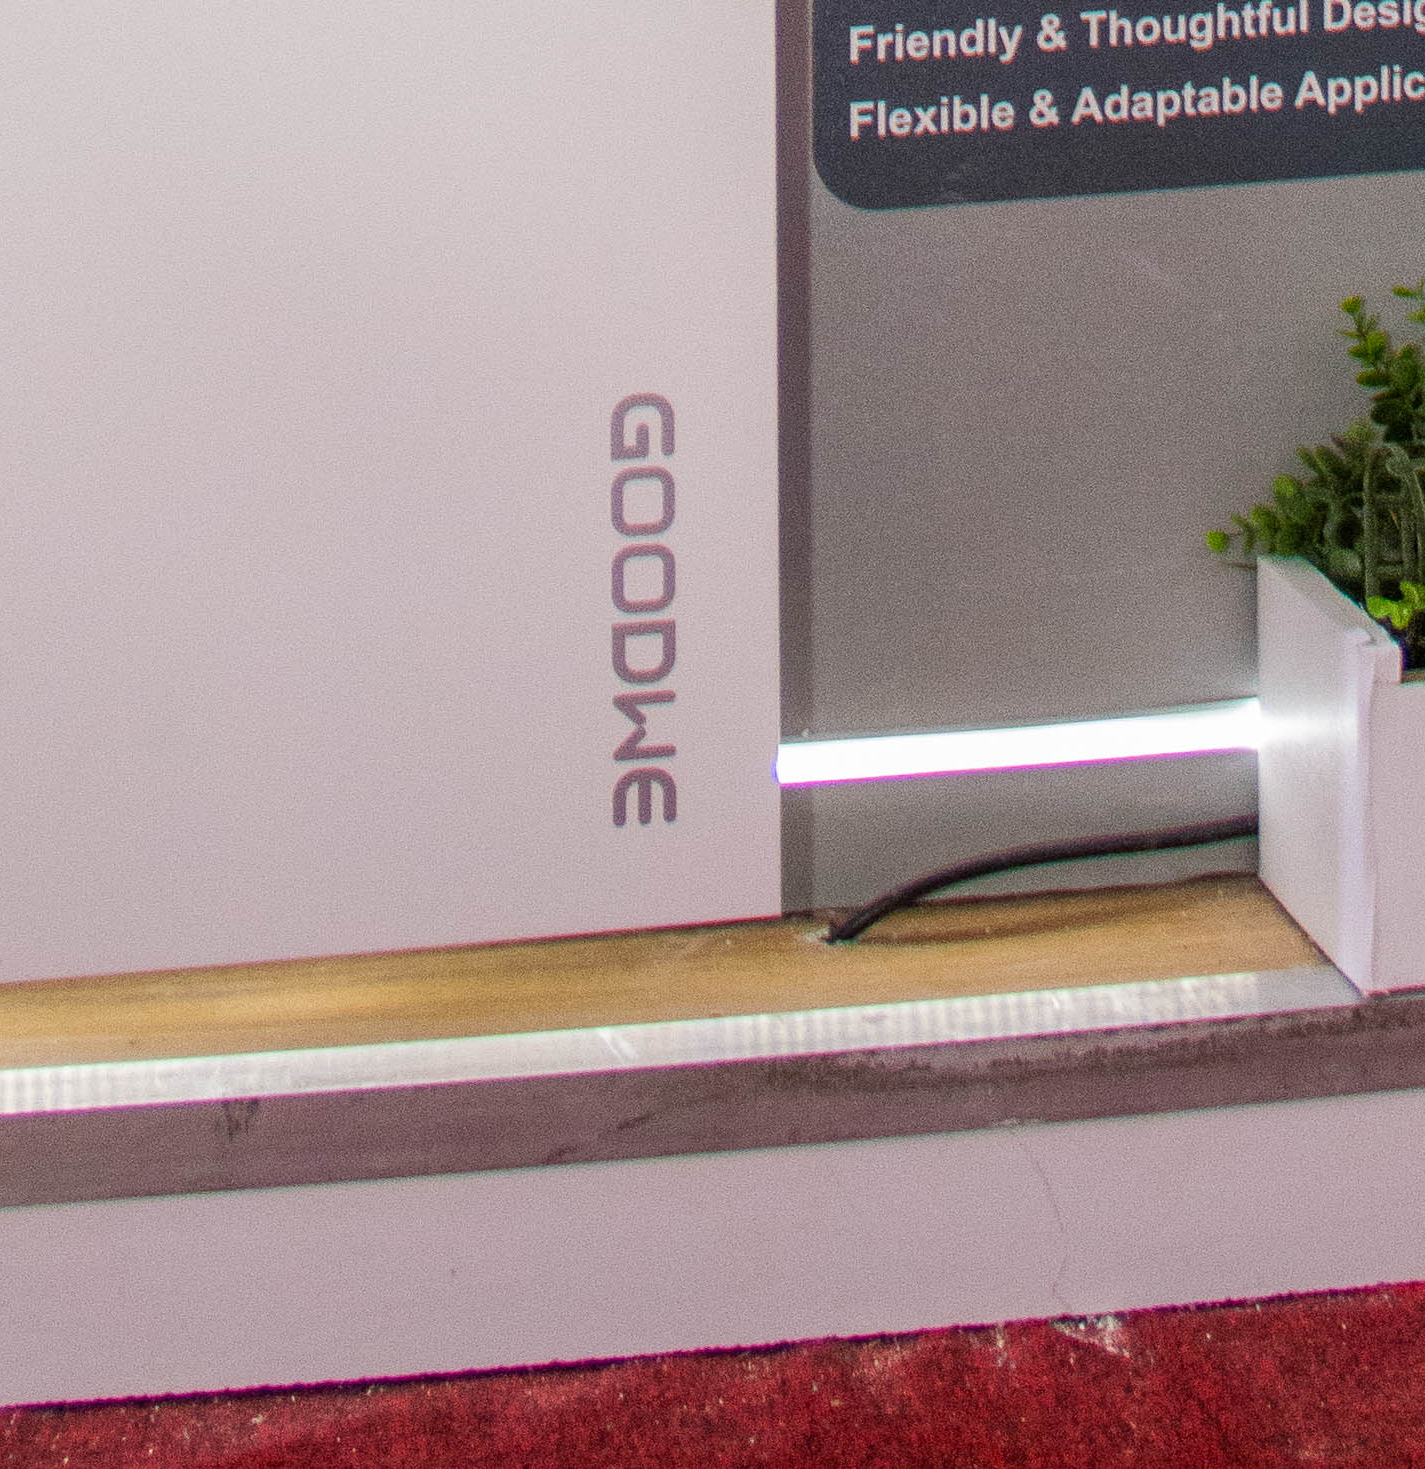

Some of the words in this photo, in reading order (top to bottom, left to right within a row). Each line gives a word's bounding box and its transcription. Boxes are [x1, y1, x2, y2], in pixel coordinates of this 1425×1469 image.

[848, 17, 1023, 65] Friendly
[1034, 12, 1068, 53] &
[848, 92, 1016, 142] Flexible
[1029, 88, 1061, 130] &
[1071, 74, 1284, 128] Adaptable
[610, 392, 677, 828] GOODWE
